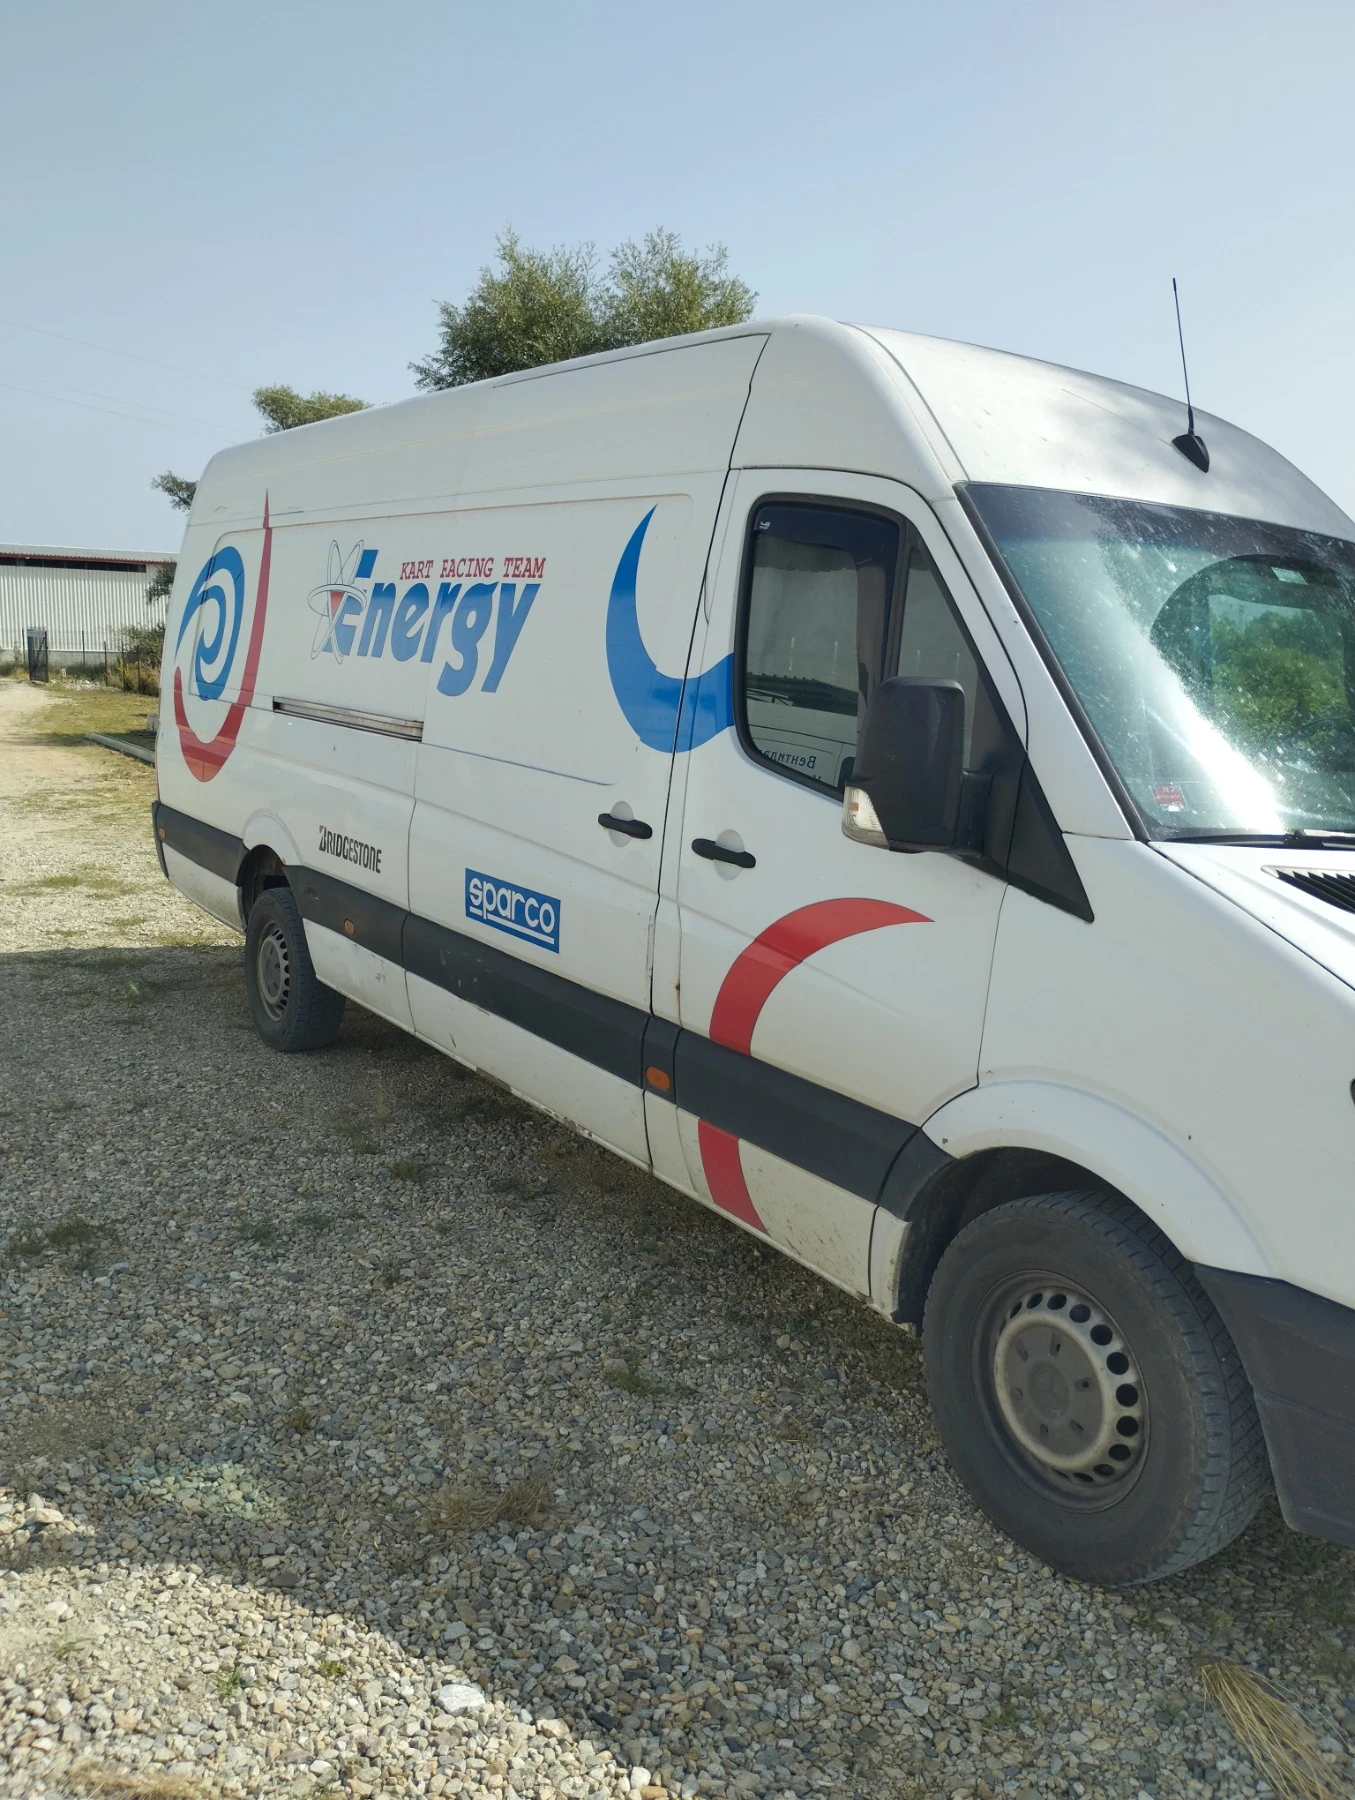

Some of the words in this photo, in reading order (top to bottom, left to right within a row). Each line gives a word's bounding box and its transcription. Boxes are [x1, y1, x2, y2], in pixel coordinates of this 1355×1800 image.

[399, 560, 434, 580] KART
[503, 557, 547, 578] TEAM
[318, 824, 382, 874] BRIDGESTONE
[468, 877, 556, 934] sparco
